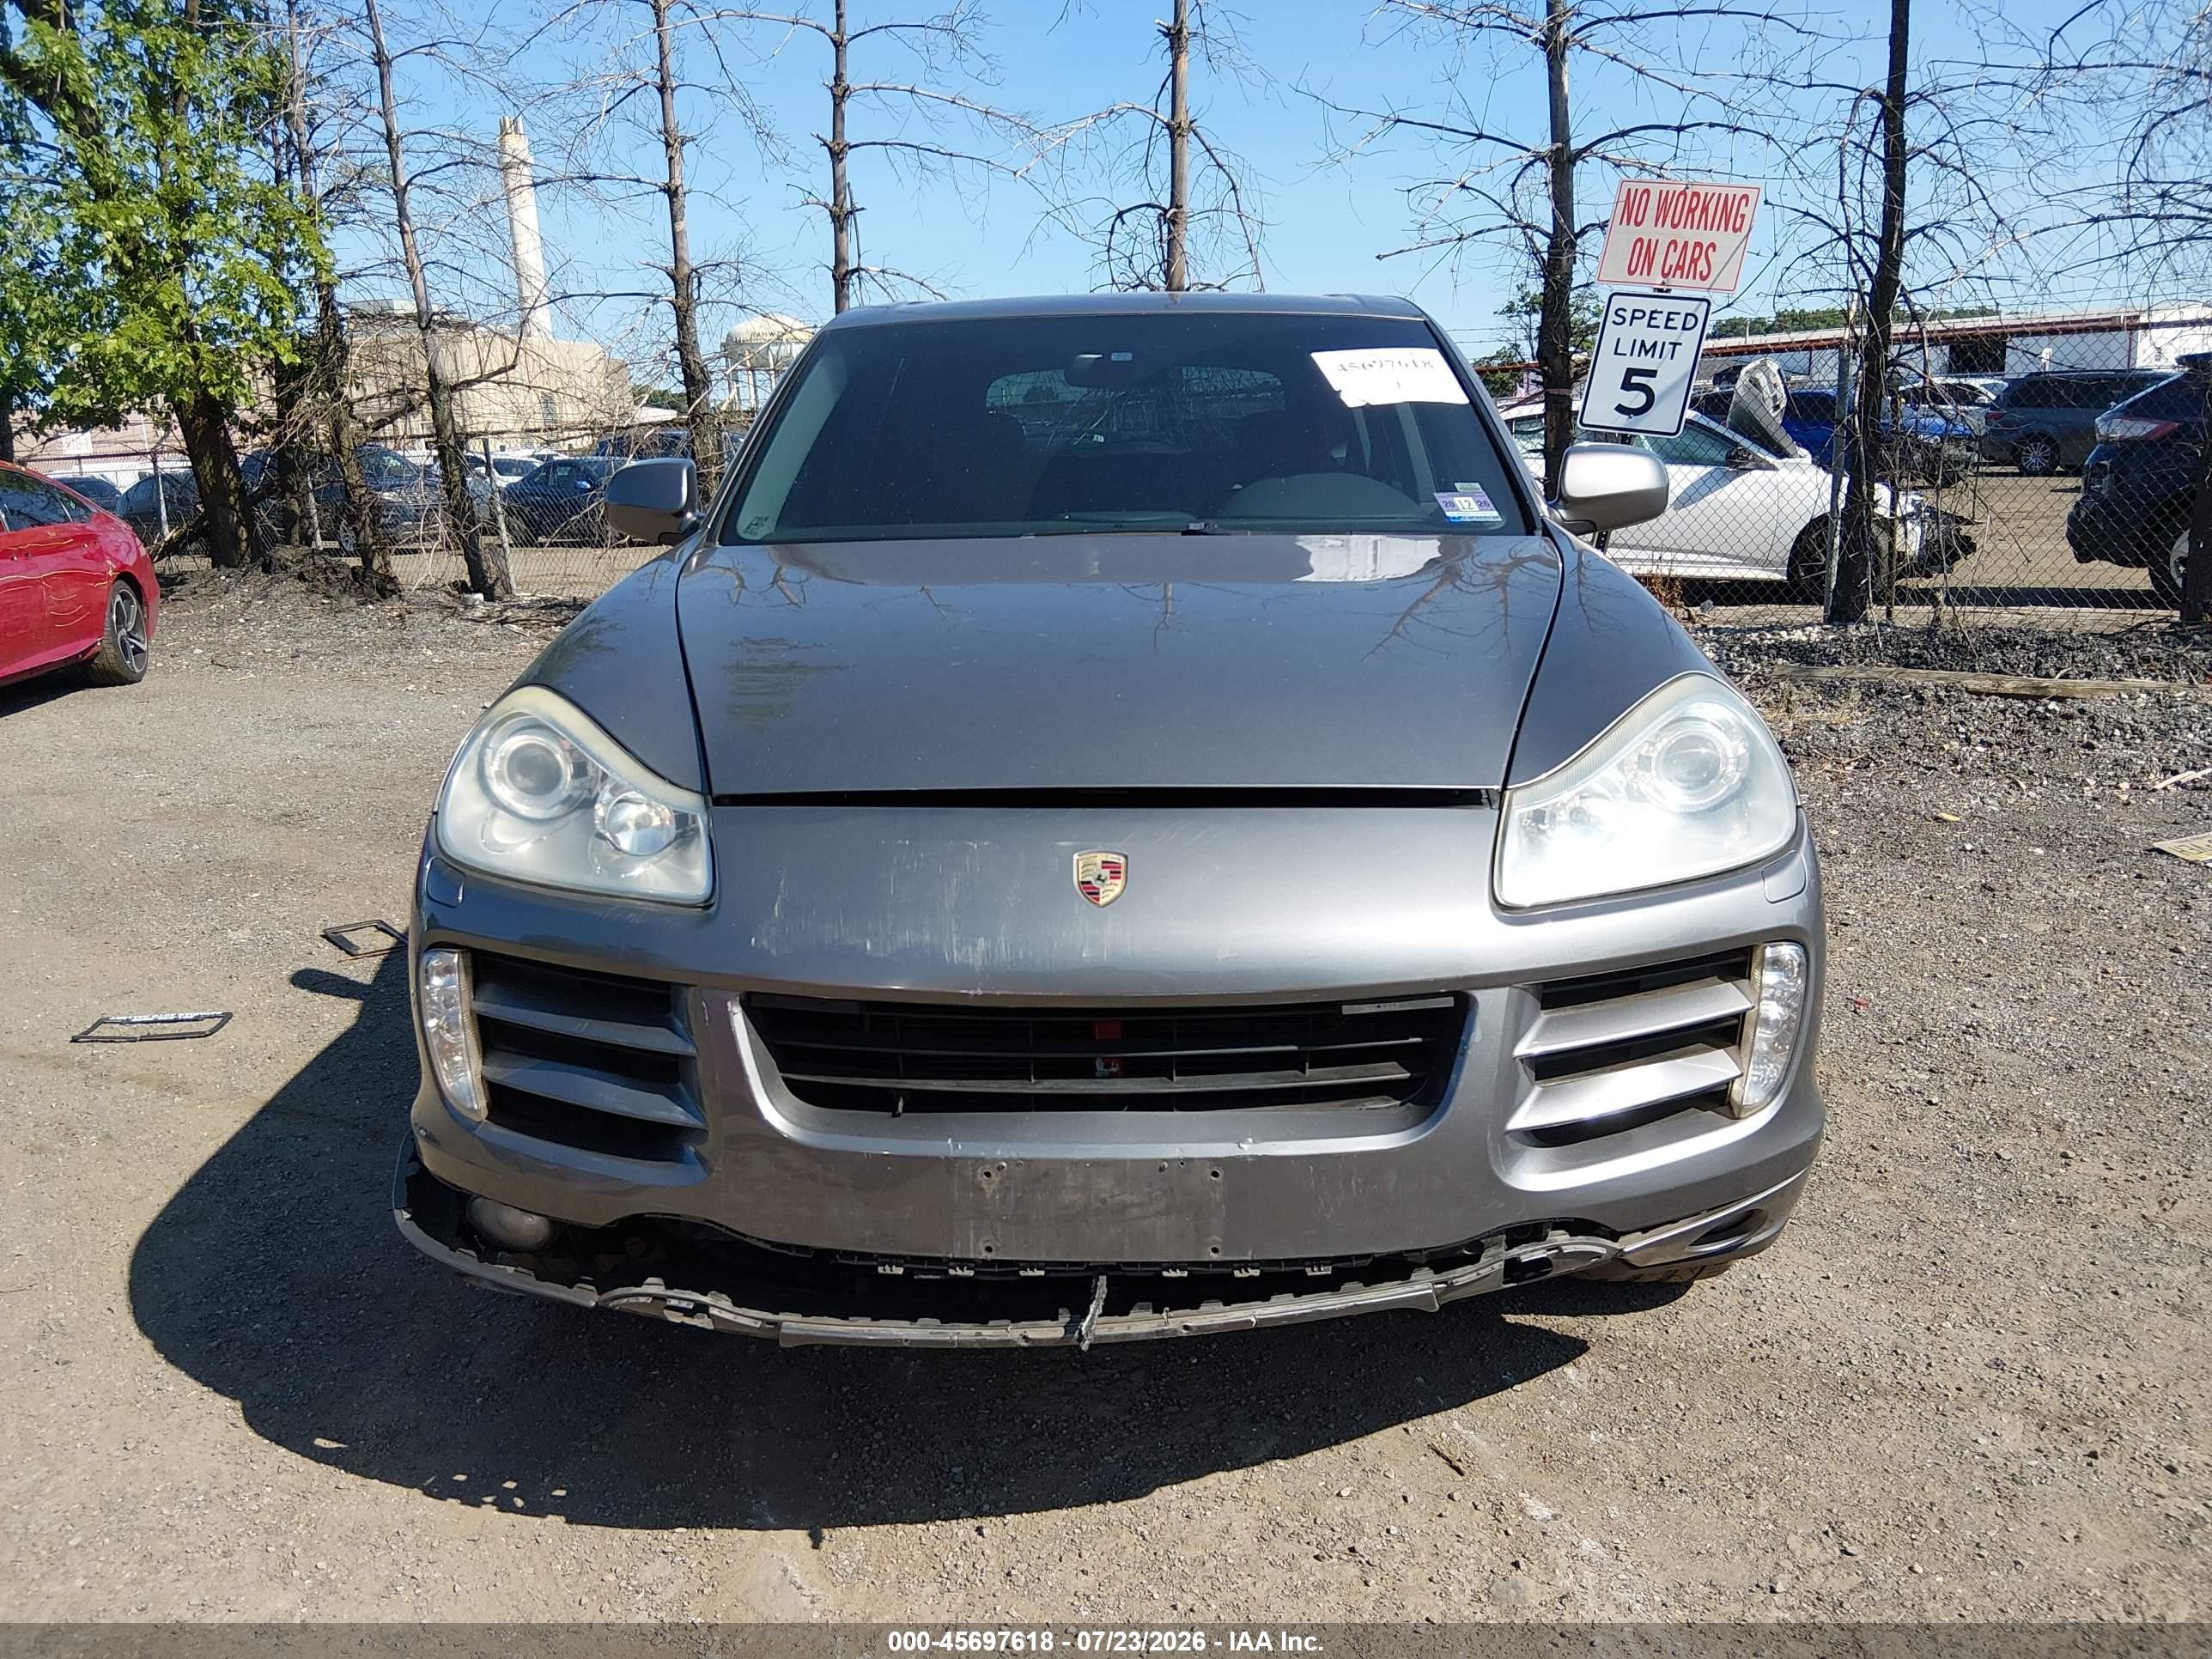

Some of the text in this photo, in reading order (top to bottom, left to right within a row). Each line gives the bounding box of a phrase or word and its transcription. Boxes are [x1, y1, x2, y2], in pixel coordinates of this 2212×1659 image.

[1619, 188, 1749, 234] NO WORKING
[1627, 237, 1717, 282] ON CARS
[1612, 307, 1698, 331] SPEED
[1613, 337, 1682, 361] LIMIT
[1613, 367, 1658, 416] 5
[1457, 499, 1474, 510] 12
